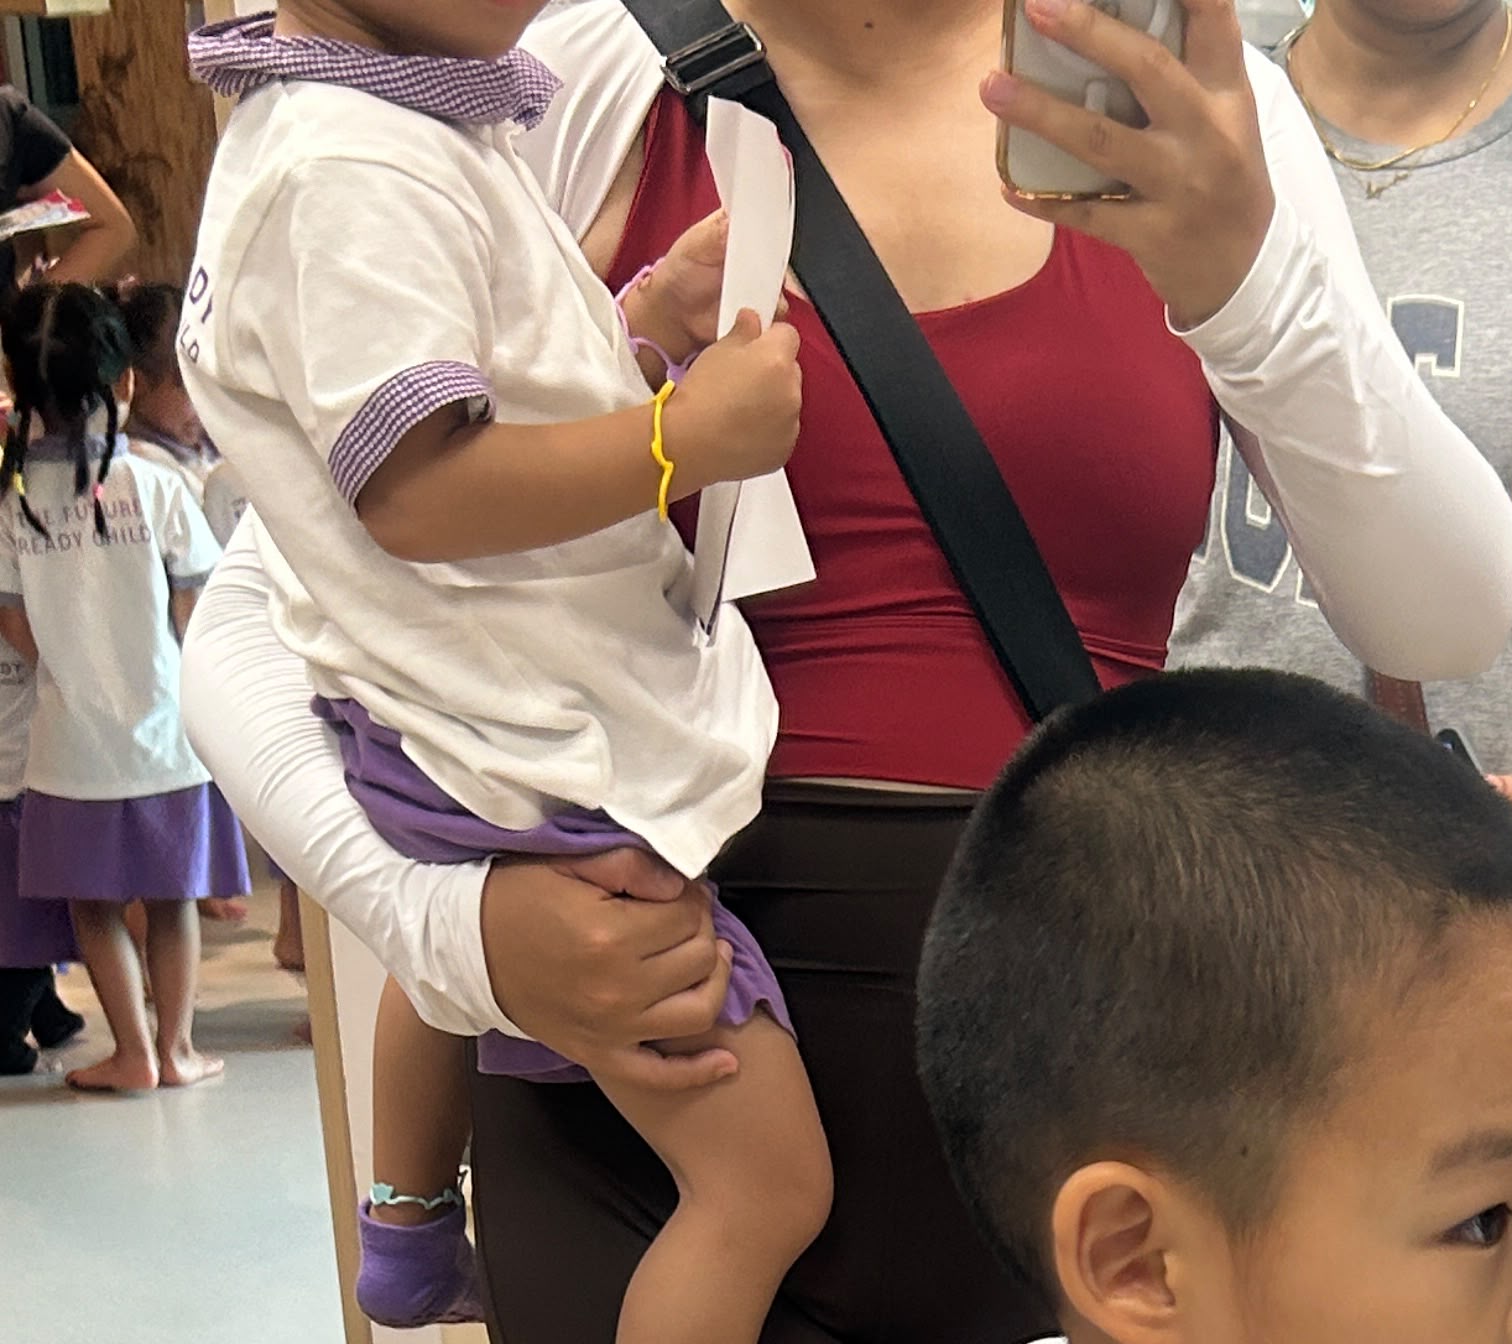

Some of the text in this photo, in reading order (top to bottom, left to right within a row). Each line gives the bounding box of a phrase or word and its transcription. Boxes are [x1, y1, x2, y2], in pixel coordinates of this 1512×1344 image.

[17, 500, 143, 528] TE FUURE
[17, 532, 83, 555] READY
